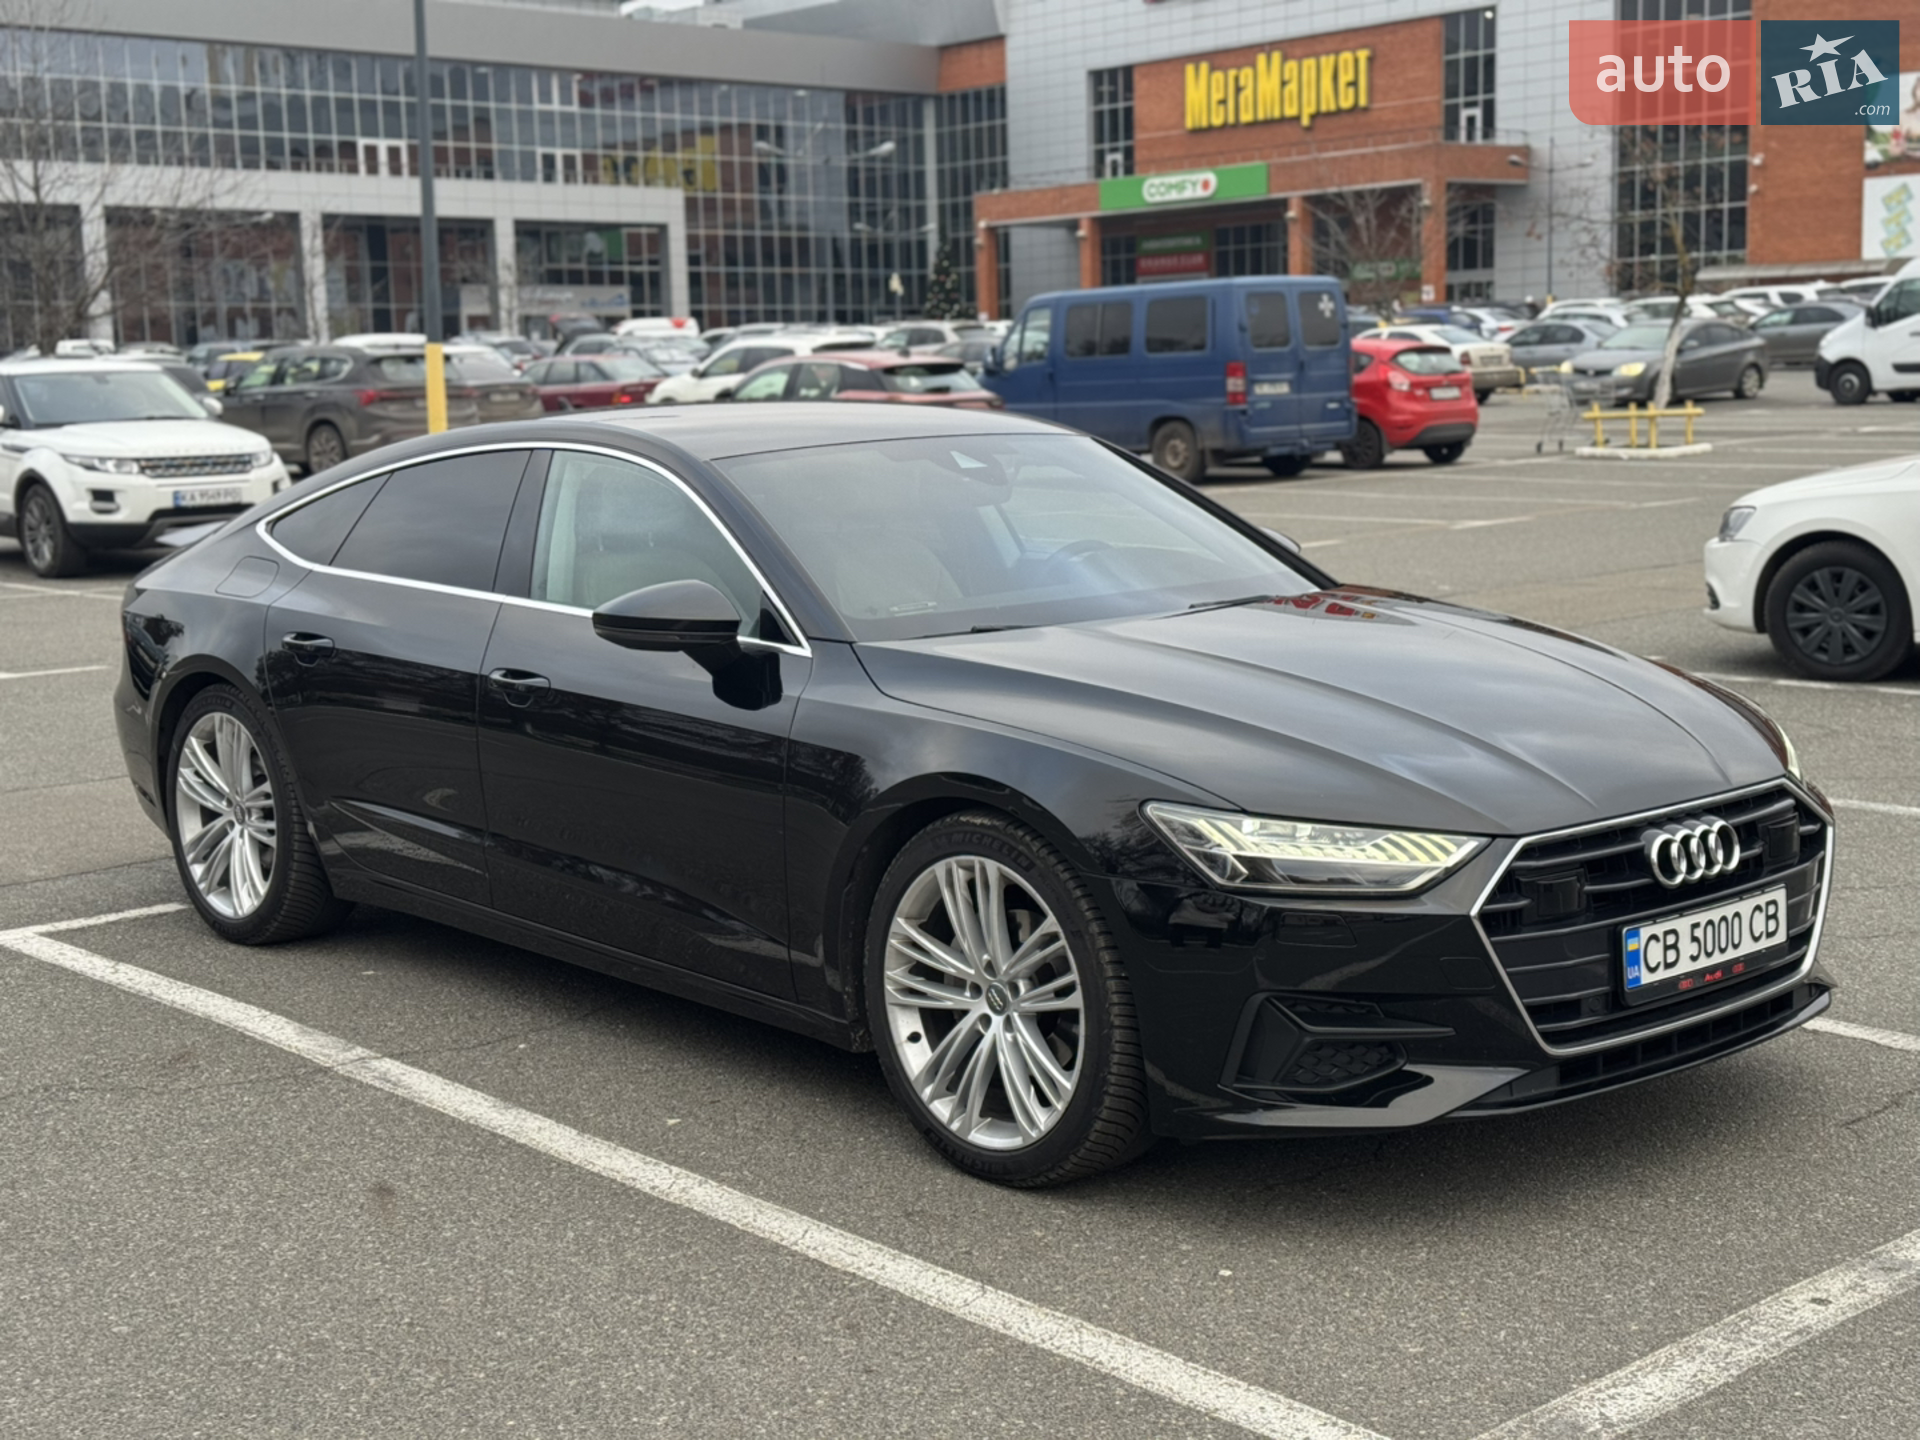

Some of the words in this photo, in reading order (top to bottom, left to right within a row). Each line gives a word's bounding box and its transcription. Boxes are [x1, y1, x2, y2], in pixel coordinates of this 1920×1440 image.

[1185, 49, 1371, 130] МегаМаркет
[1146, 179, 1199, 198] COMFY
[950, 832, 1031, 869] MICHELIN
[1643, 928, 1680, 974] CB
[1689, 911, 1742, 962] 5000
[1749, 899, 1780, 943] CB
[1627, 965, 1640, 979] UA
[1704, 970, 1724, 982] Audi
